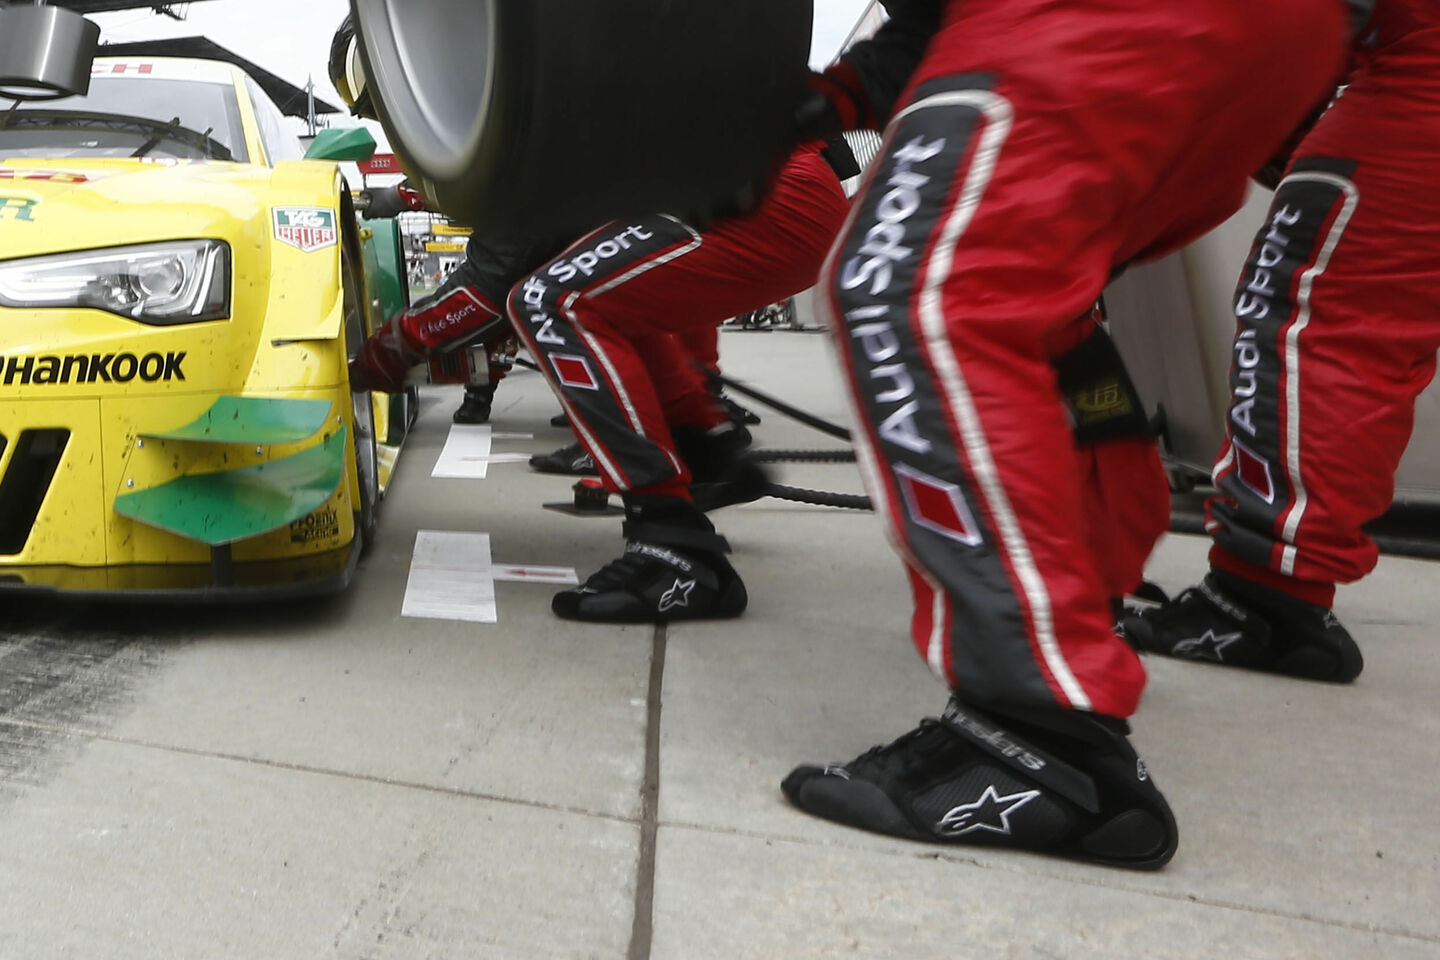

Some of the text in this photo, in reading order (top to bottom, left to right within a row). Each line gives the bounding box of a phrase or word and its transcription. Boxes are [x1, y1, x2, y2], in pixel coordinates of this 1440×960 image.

[284, 208, 326, 228] TAG
[523, 224, 654, 346] Audi Sport
[841, 134, 947, 455] Audi Sport
[1230, 203, 1302, 437] Audi Sport
